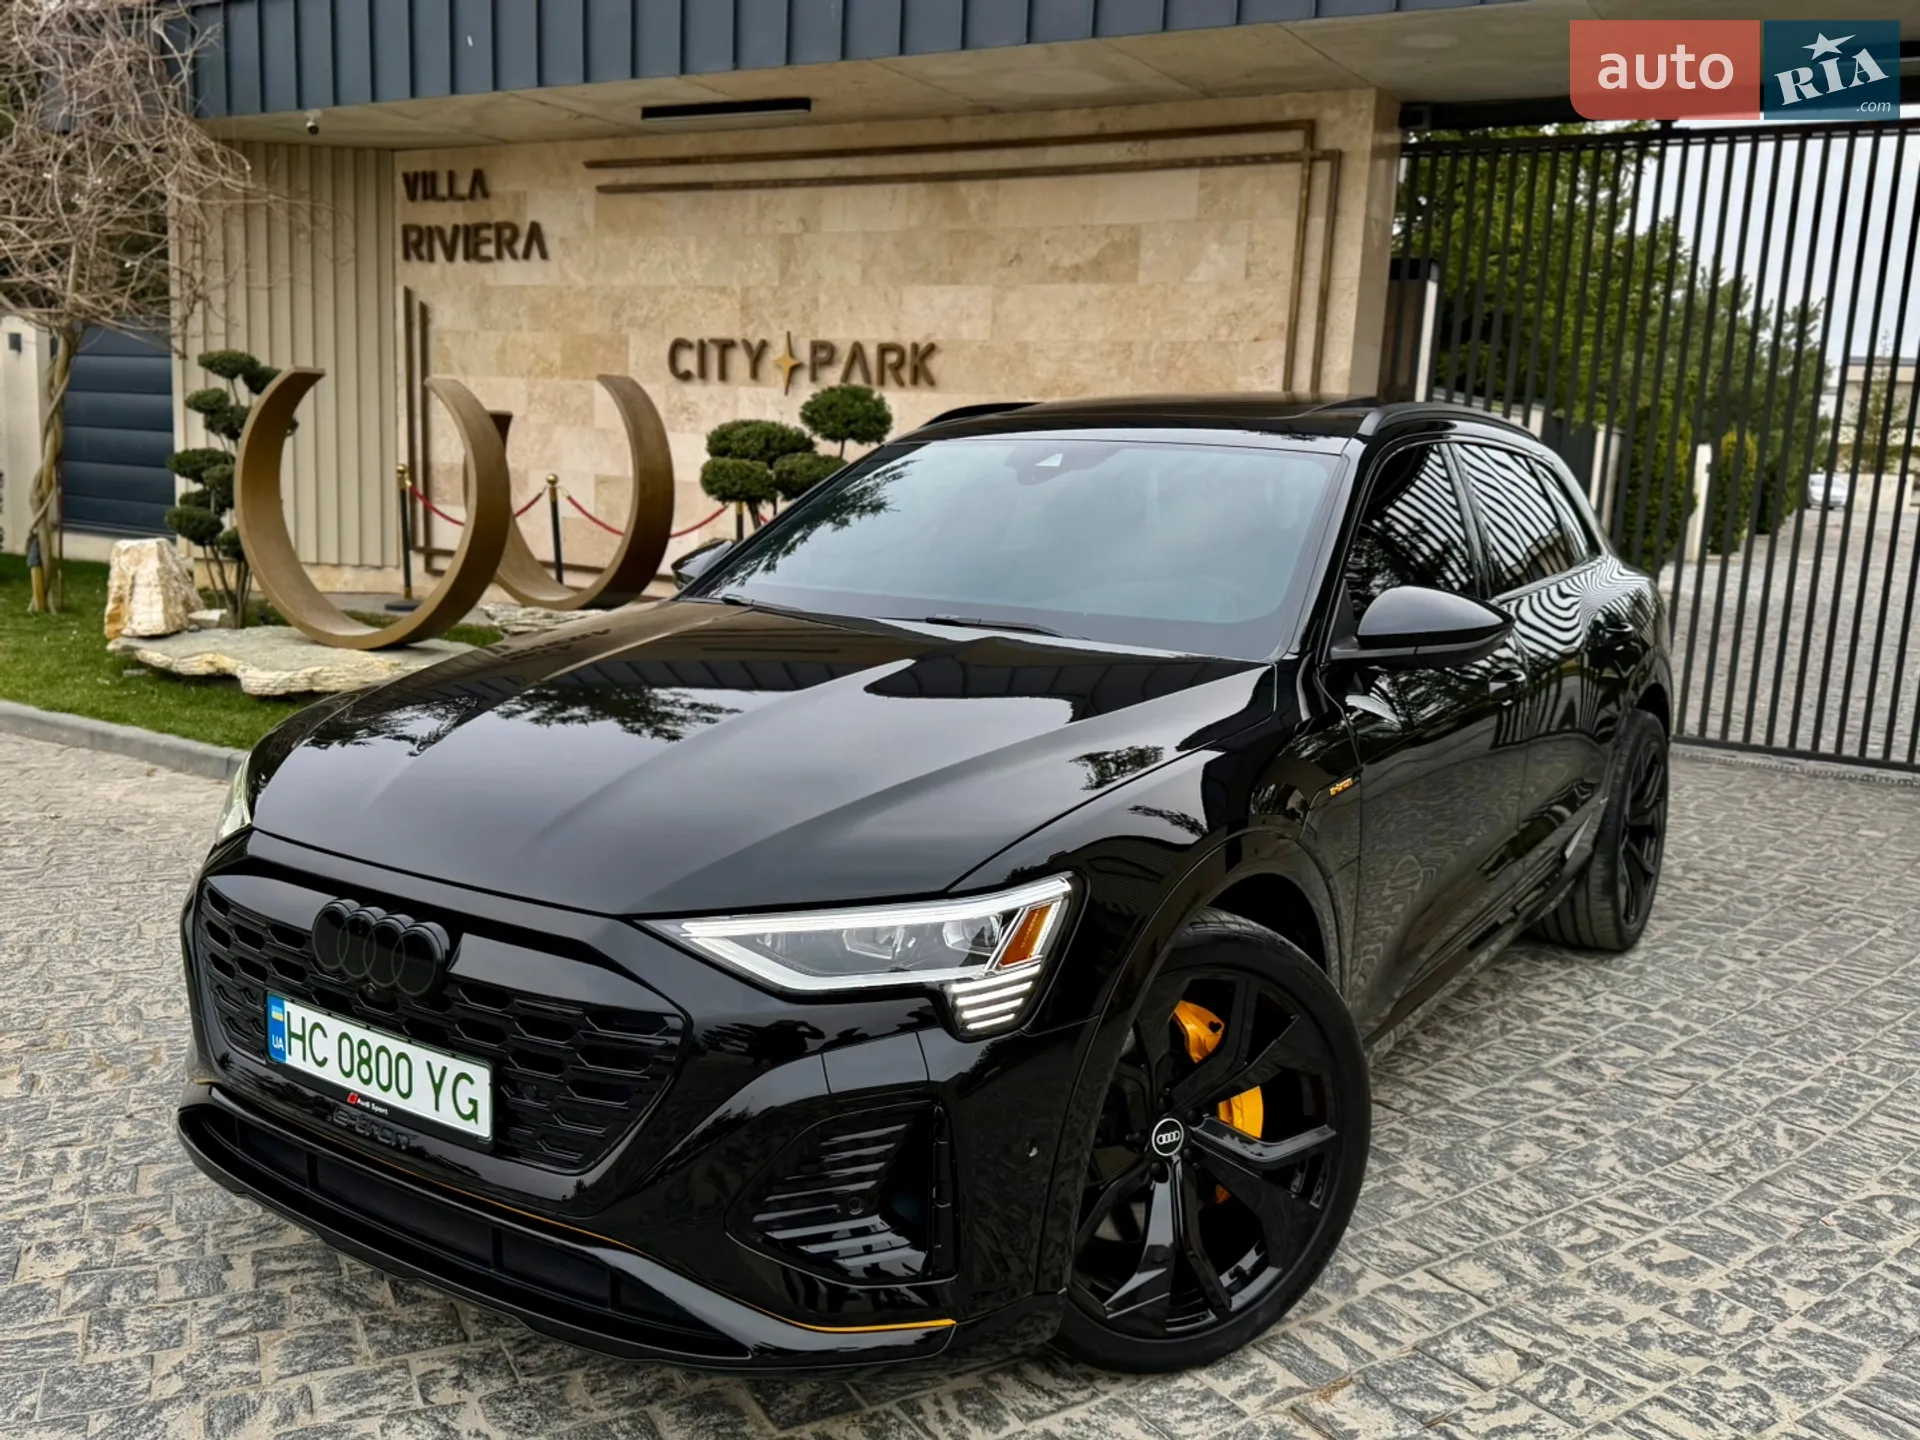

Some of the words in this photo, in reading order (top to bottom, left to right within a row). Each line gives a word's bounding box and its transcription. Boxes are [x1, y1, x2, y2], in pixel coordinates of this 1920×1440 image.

[403, 169, 489, 201] VILLA
[402, 221, 549, 262] RIVIERA
[667, 338, 769, 382] CITY
[809, 341, 937, 386] PARK
[271, 1034, 285, 1051] UA
[287, 1011, 329, 1068] HC
[337, 1031, 413, 1100] 0800
[426, 1060, 479, 1125] YG
[371, 1102, 389, 1116] Sport
